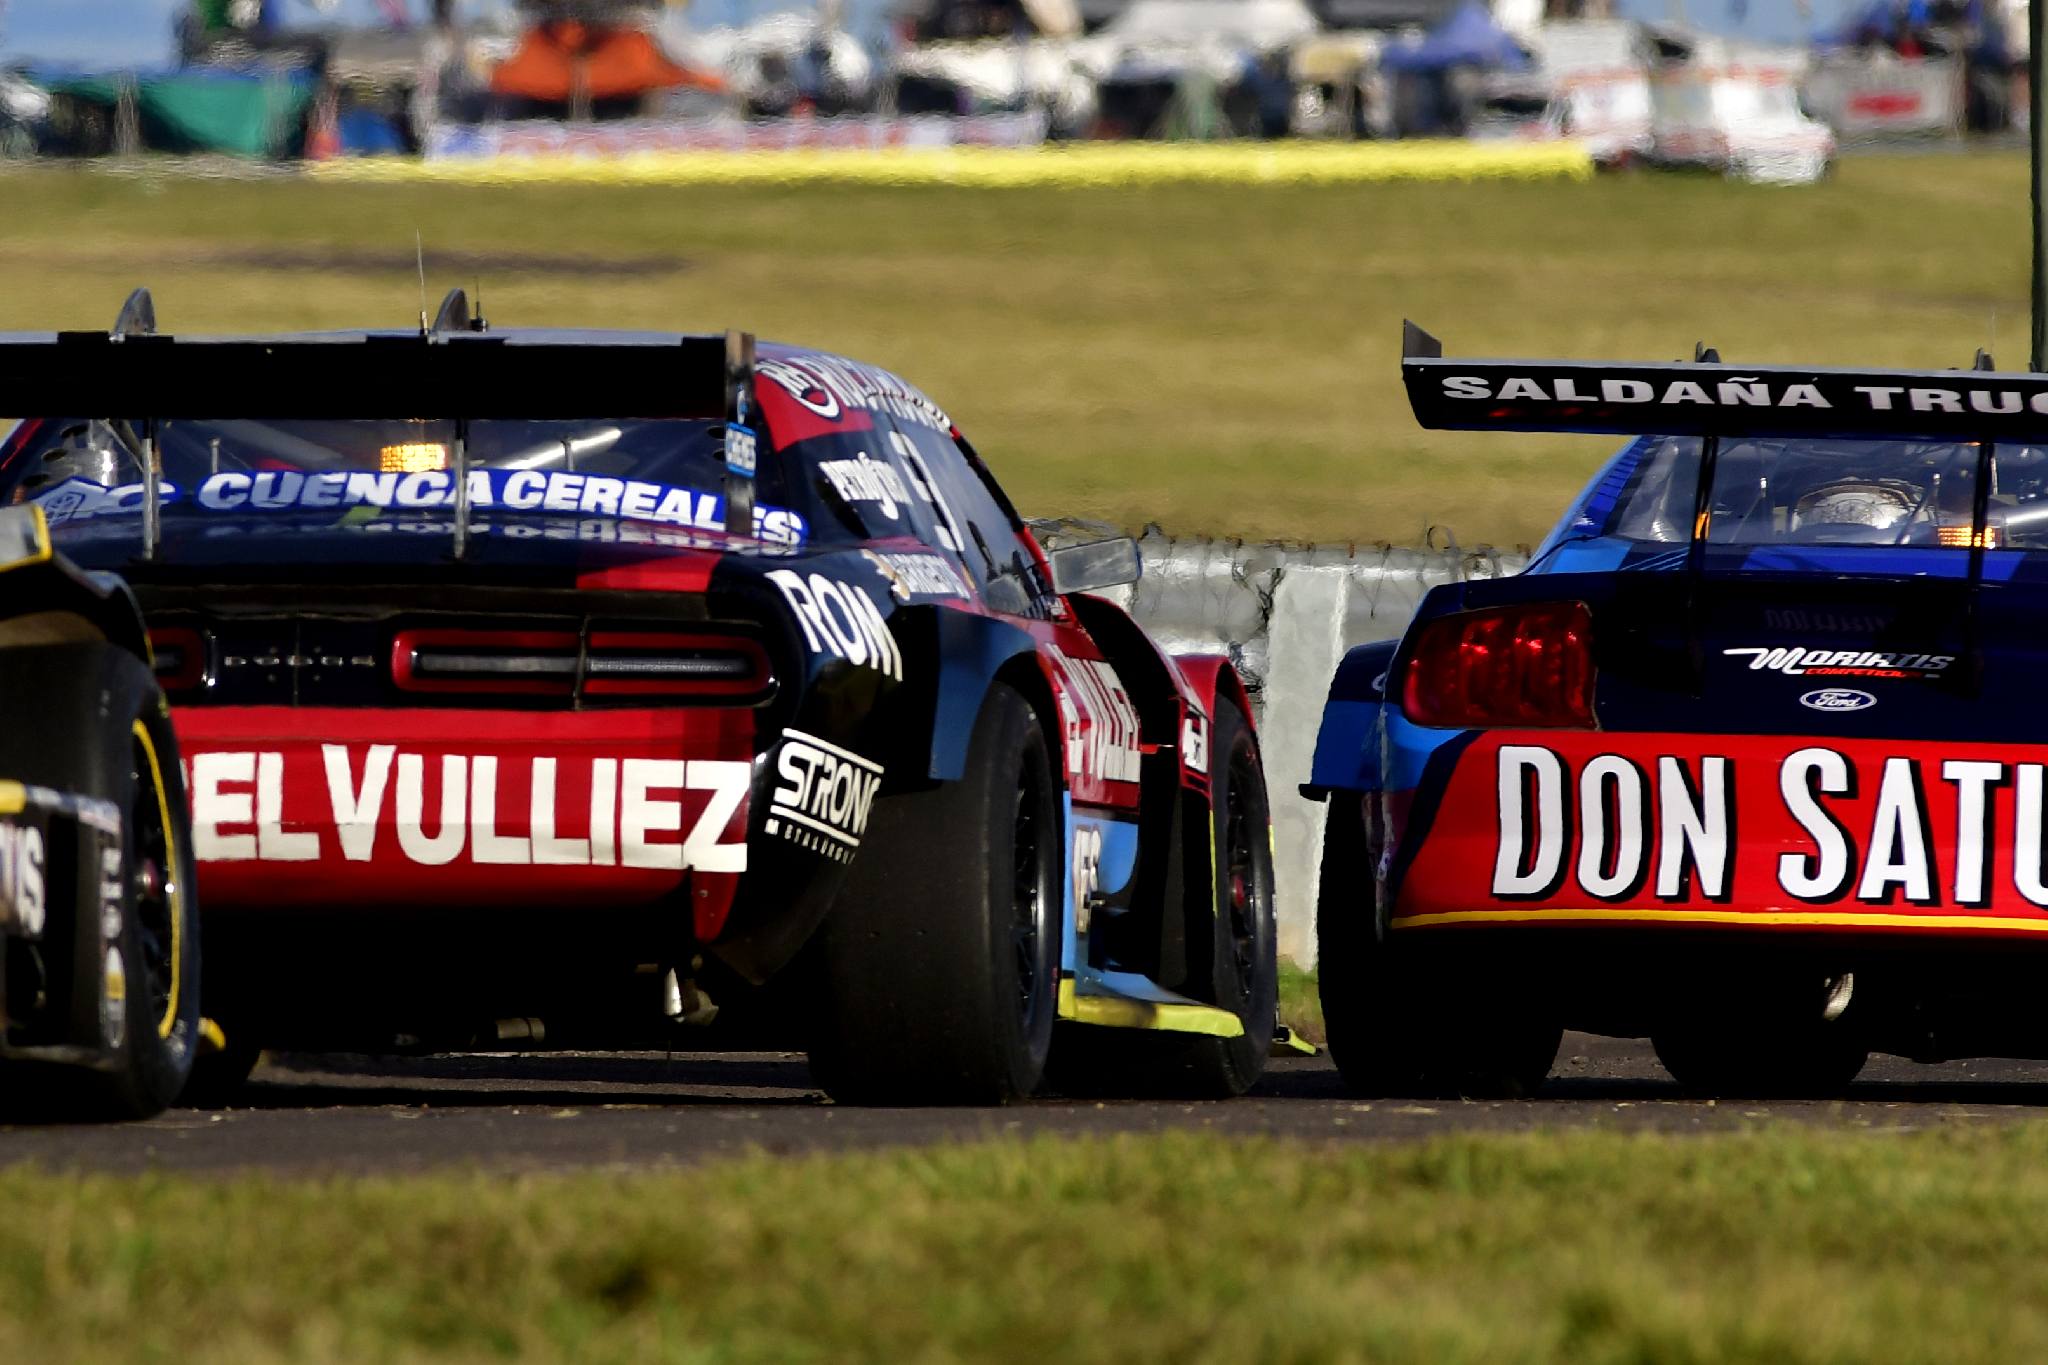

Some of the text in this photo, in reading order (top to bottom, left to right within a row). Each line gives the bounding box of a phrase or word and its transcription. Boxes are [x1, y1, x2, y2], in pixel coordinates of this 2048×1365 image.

[200, 470, 490, 508] CUENCA
[181, 743, 748, 873] EL VULLIEZ
[1492, 745, 2048, 906] DON SATU
